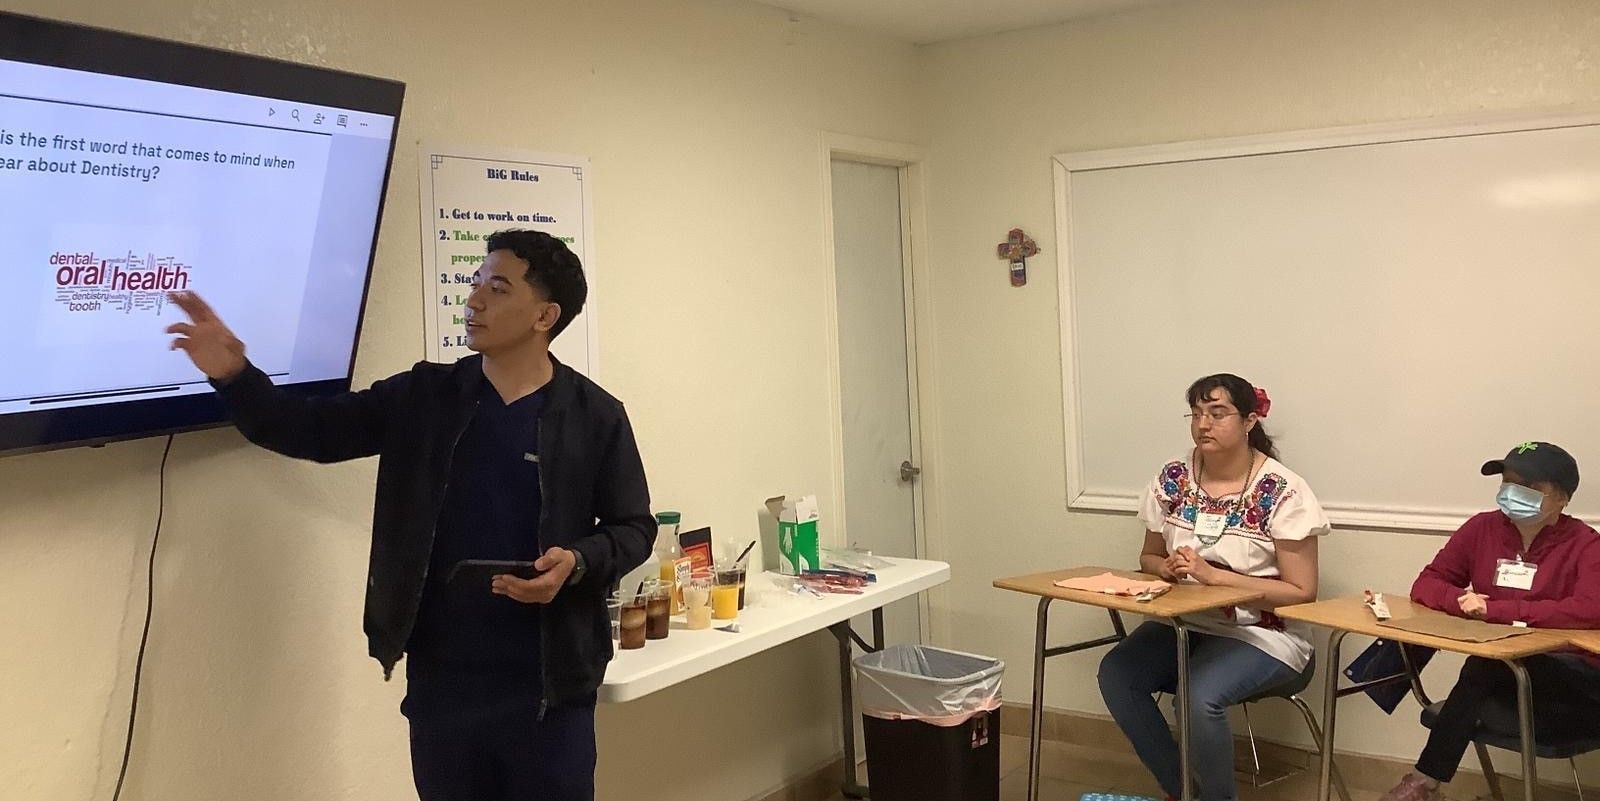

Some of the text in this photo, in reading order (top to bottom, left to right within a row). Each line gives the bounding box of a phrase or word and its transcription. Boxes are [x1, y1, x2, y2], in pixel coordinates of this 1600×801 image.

[0, 129, 295, 169] is the first word that comes to mind when
[27, 156, 77, 174] about
[80, 160, 160, 182] Dentistry?
[487, 168, 539, 182] BiG Rules
[439, 208, 557, 223] 1. Get to work on time.
[439, 229, 450, 241] 2.
[453, 230, 480, 241] Take
[50, 251, 93, 265] dental
[451, 255, 486, 265] proper
[56, 259, 106, 286] oral
[111, 266, 188, 291] health
[440, 273, 451, 284] 3.
[71, 292, 109, 302] dentistry
[440, 295, 452, 306] 4.
[69, 300, 101, 312] tooth
[442, 335, 453, 347] 5.
